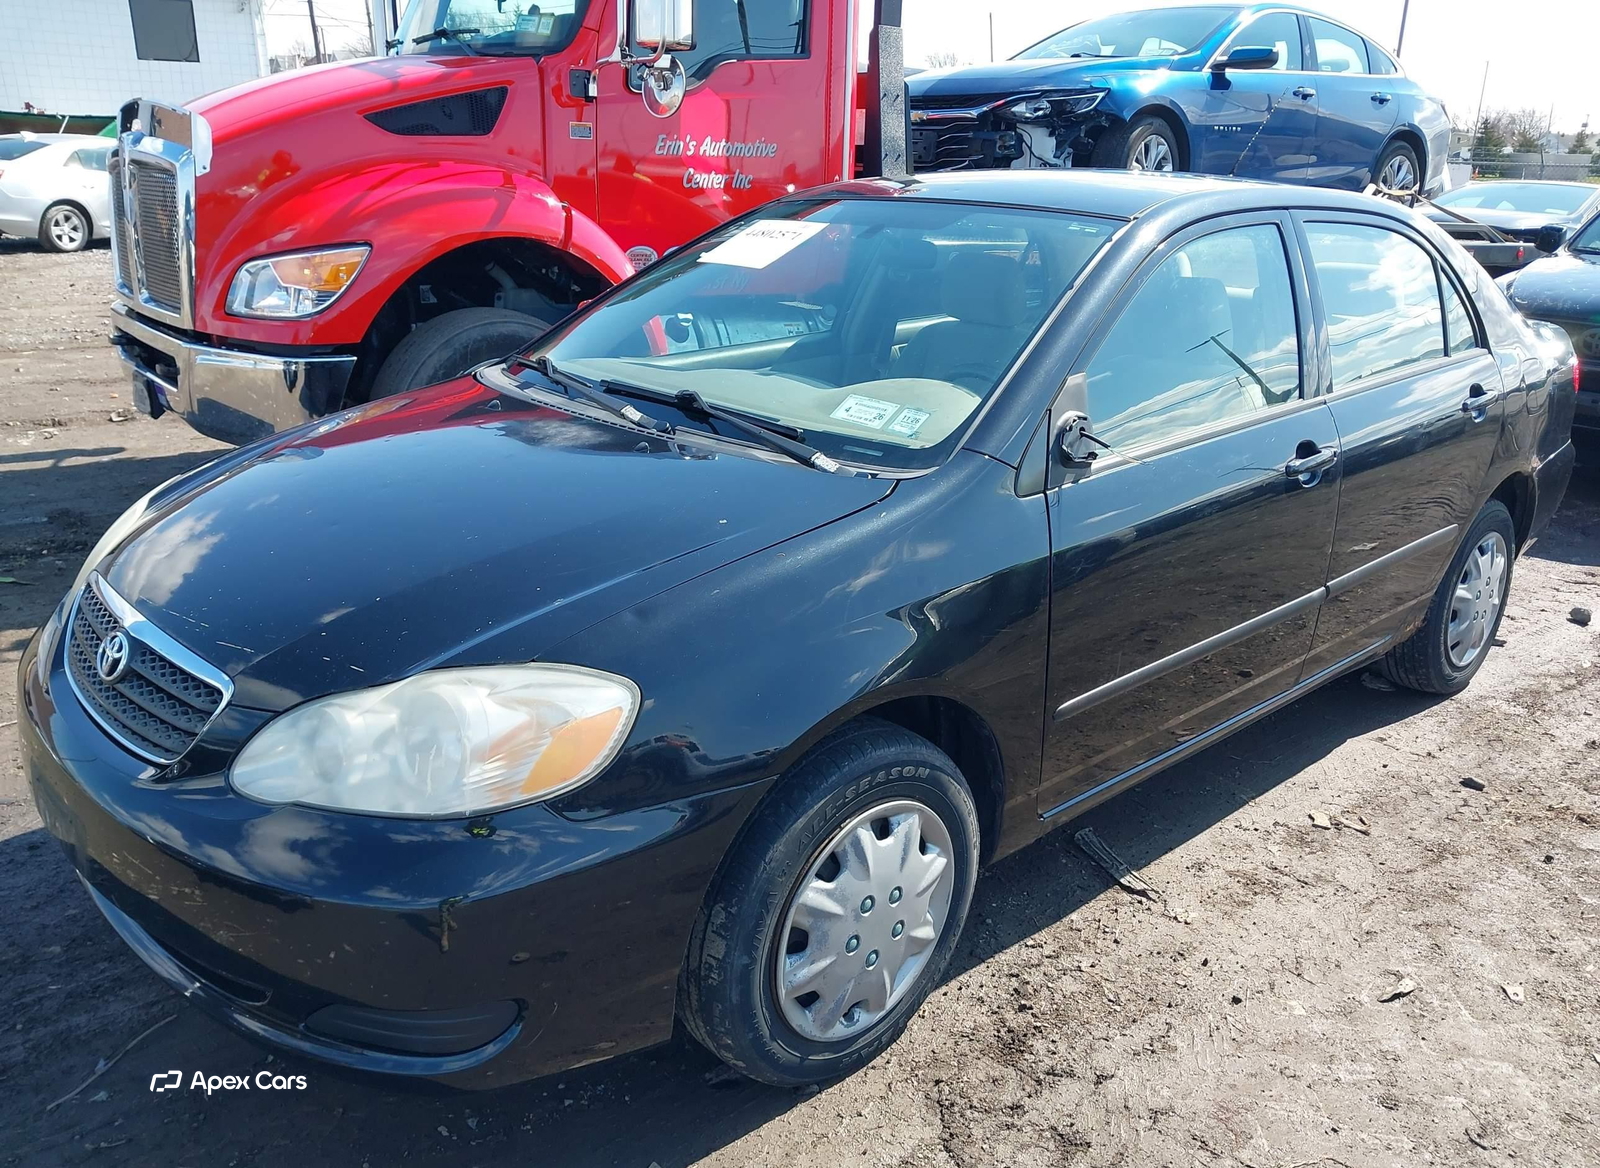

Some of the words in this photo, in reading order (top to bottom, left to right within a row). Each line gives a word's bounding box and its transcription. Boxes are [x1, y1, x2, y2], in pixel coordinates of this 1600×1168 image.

[655, 134, 697, 156] Erin's
[699, 135, 778, 158] Automotive
[682, 167, 729, 189] Center
[731, 169, 754, 189] Inc
